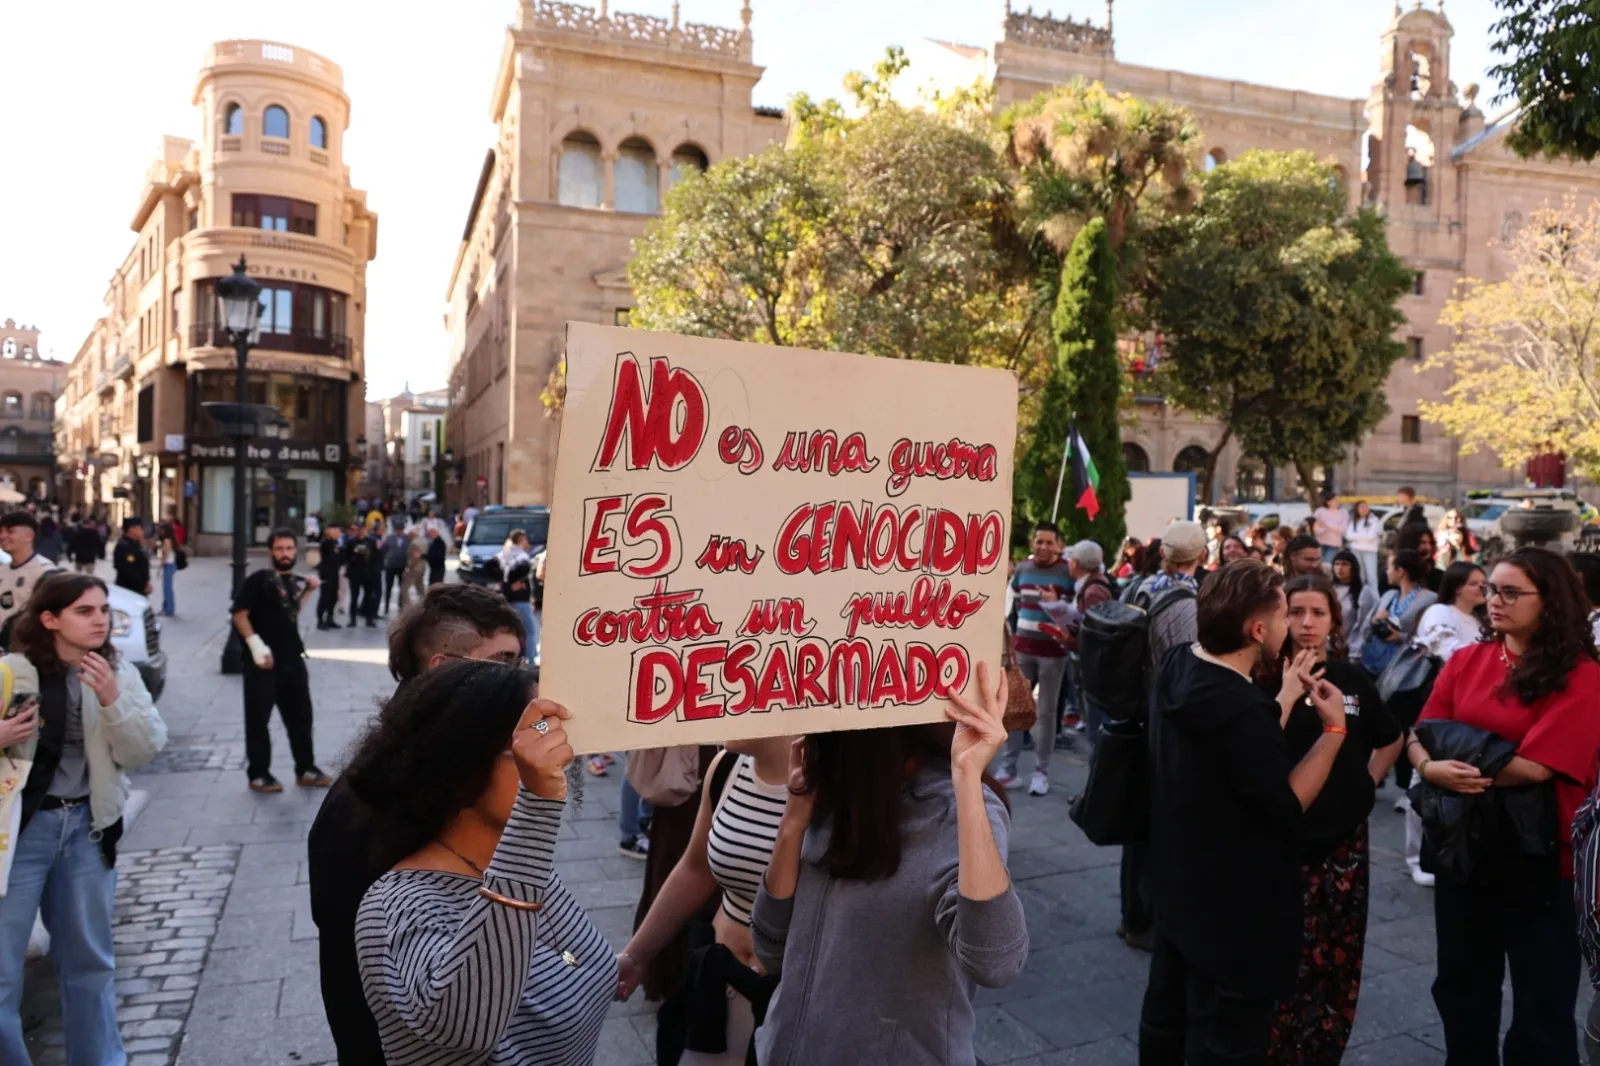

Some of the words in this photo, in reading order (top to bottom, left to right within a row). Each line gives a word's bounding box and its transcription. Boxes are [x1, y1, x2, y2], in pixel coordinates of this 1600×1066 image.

[191, 444, 271, 459] Deutshe
[590, 351, 709, 473] NO
[718, 425, 764, 475] es
[773, 430, 880, 476] una
[886, 437, 998, 497] guerra
[579, 492, 683, 579] ES
[695, 534, 765, 575] un
[773, 499, 1005, 576] GENOCIDIO
[573, 576, 722, 646] contra
[736, 597, 817, 637] un
[840, 574, 990, 642] pueblo
[627, 637, 970, 724] DESARMADO
